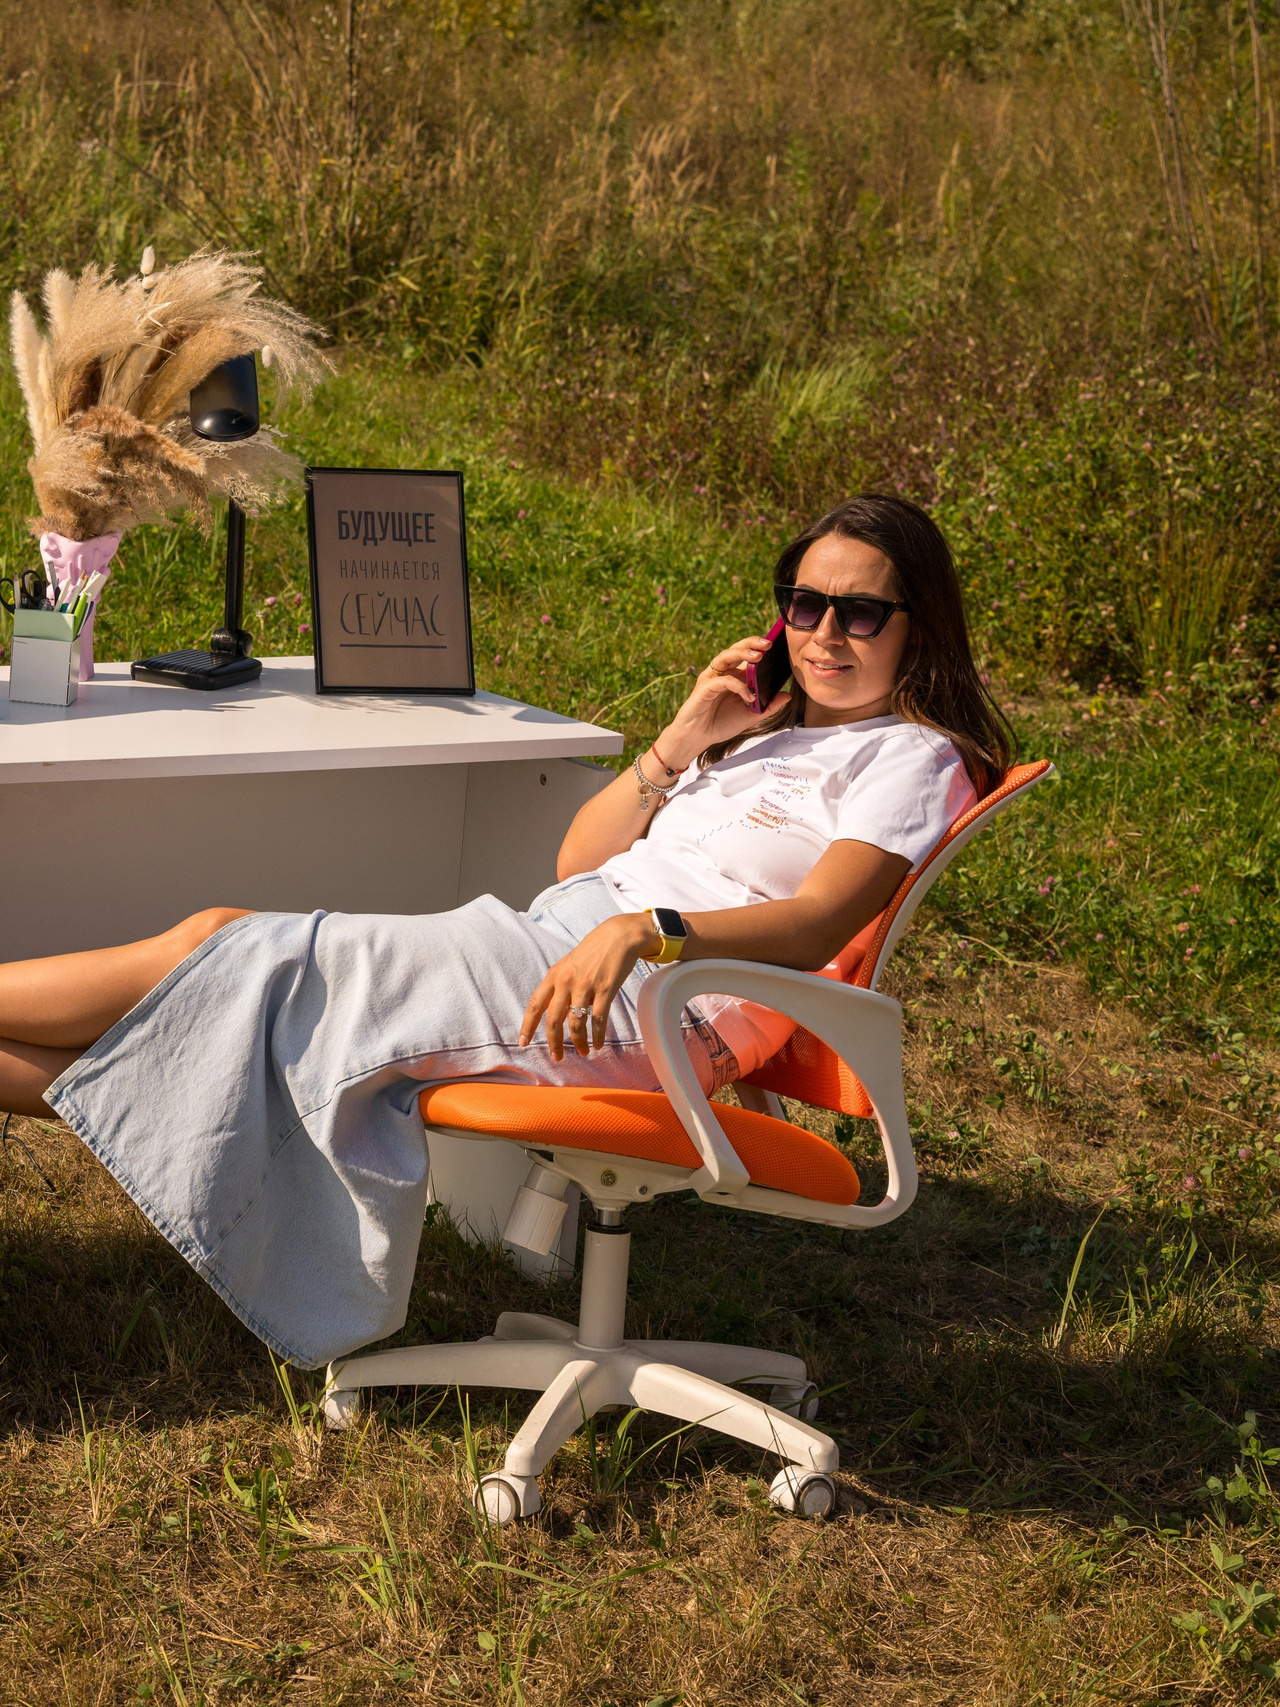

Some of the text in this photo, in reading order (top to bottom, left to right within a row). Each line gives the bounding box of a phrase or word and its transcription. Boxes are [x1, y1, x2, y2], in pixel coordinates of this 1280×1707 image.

[337, 509, 436, 547] БУДУЩЕЕ
[339, 559, 440, 580] НАЧИНАЕТСЯ
[340, 590, 445, 637] СЕЙЧАС
